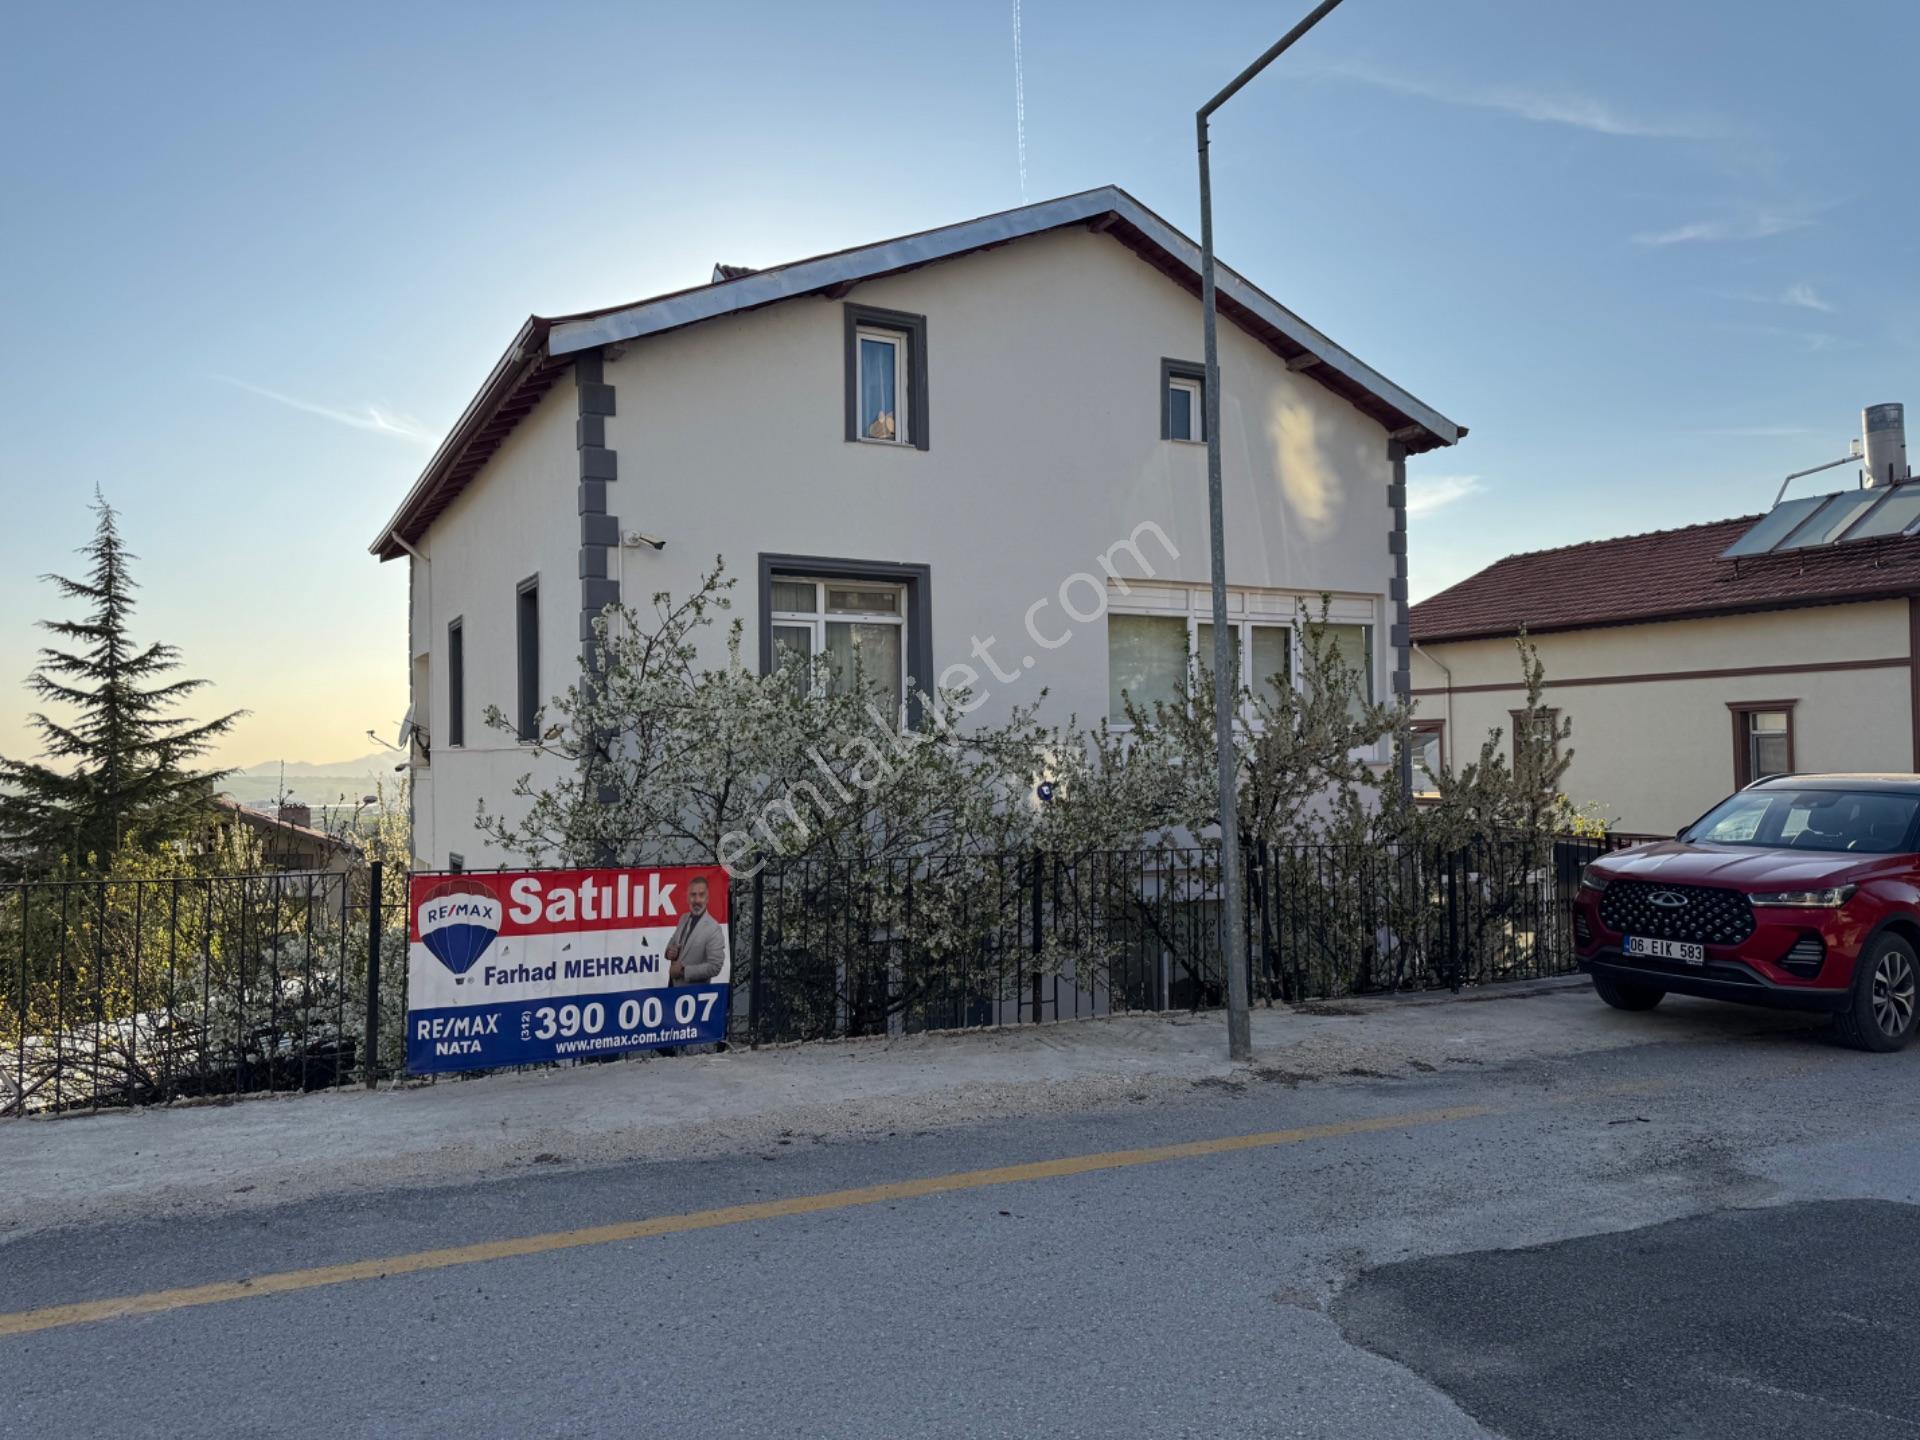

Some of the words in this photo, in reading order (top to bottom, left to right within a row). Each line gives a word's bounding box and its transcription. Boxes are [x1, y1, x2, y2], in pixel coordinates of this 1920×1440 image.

[509, 873, 677, 925] Satılık
[428, 904, 493, 923] RE/MAX
[1630, 938, 1644, 952] 06
[1651, 940, 1672, 957] EIK
[1680, 944, 1702, 960] 583
[484, 961, 556, 986] Farhad
[417, 1014, 499, 1039] RE/MAX
[520, 1010, 532, 1041] (312)
[534, 1002, 605, 1040] 390
[618, 997, 663, 1030] 00
[674, 992, 719, 1024] 07
[436, 1040, 482, 1056] NATA
[556, 1027, 697, 1053] www.remax.com.tr/nata
